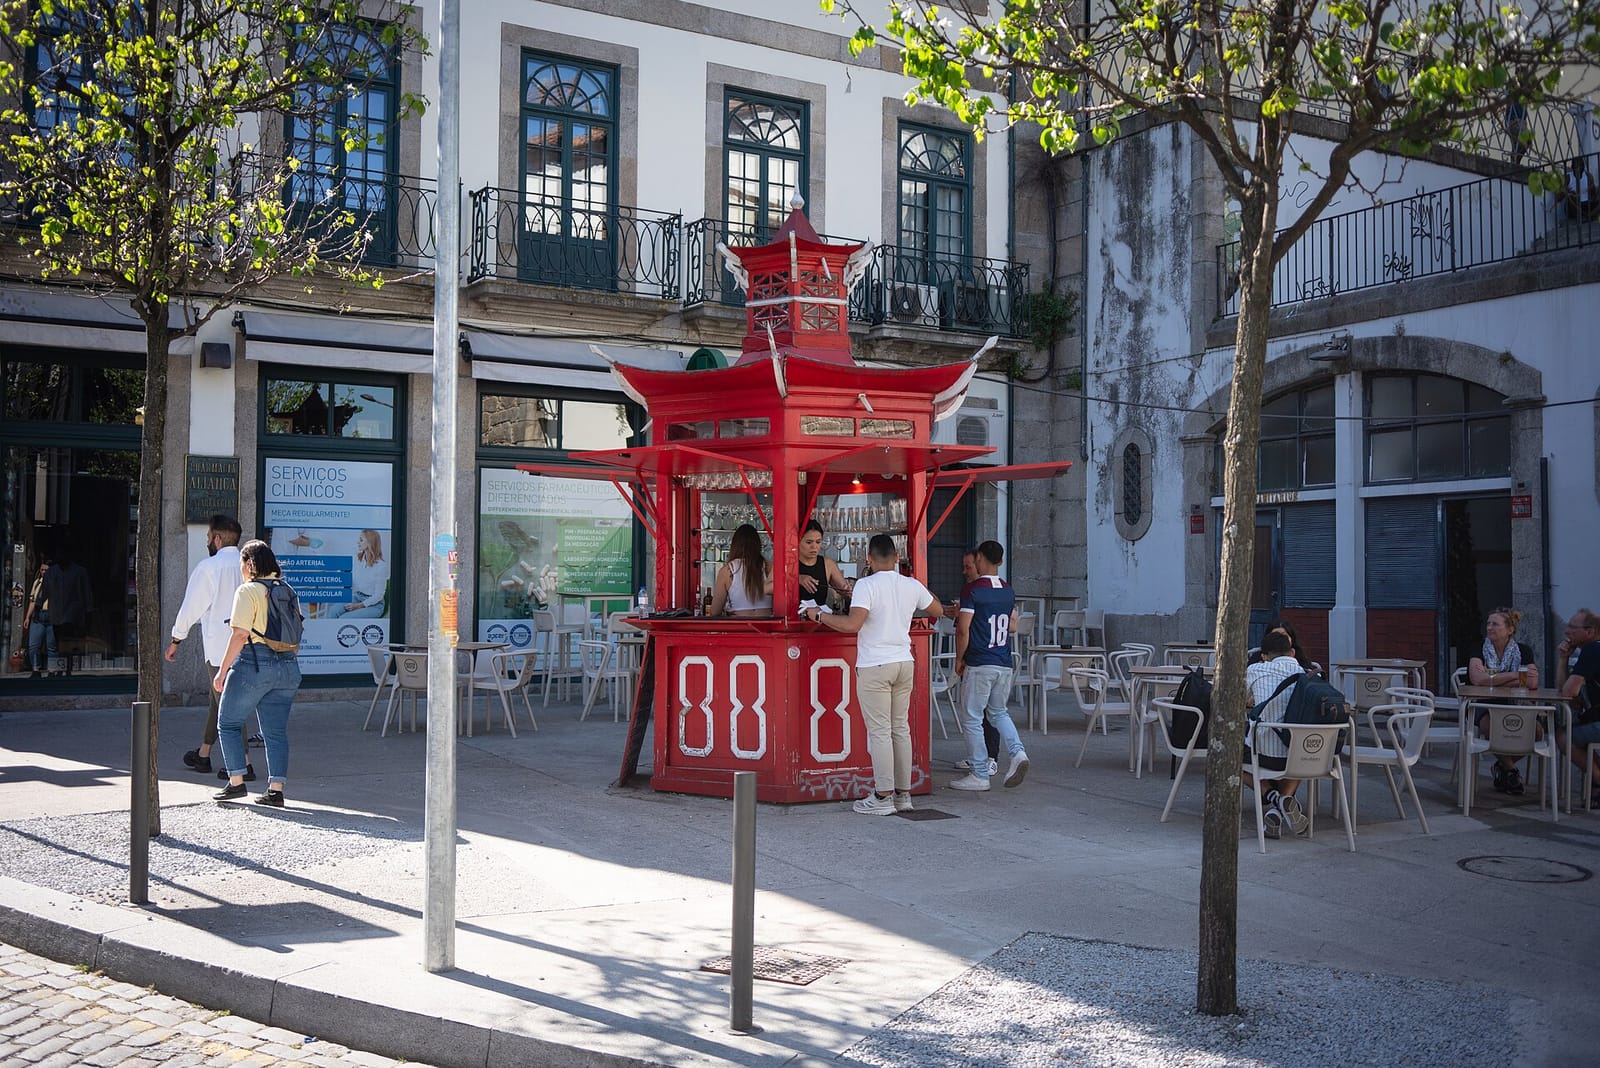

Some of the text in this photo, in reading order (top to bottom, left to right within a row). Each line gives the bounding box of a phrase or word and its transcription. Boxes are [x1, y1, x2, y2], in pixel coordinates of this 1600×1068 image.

[271, 465, 347, 484] SERVIÇOS
[271, 480, 345, 499] CLÍNICOS
[487, 492, 567, 505] DIFERENCIADOS
[271, 509, 351, 518] MEÇA REGULARMENTE!
[988, 613, 1009, 648] 18
